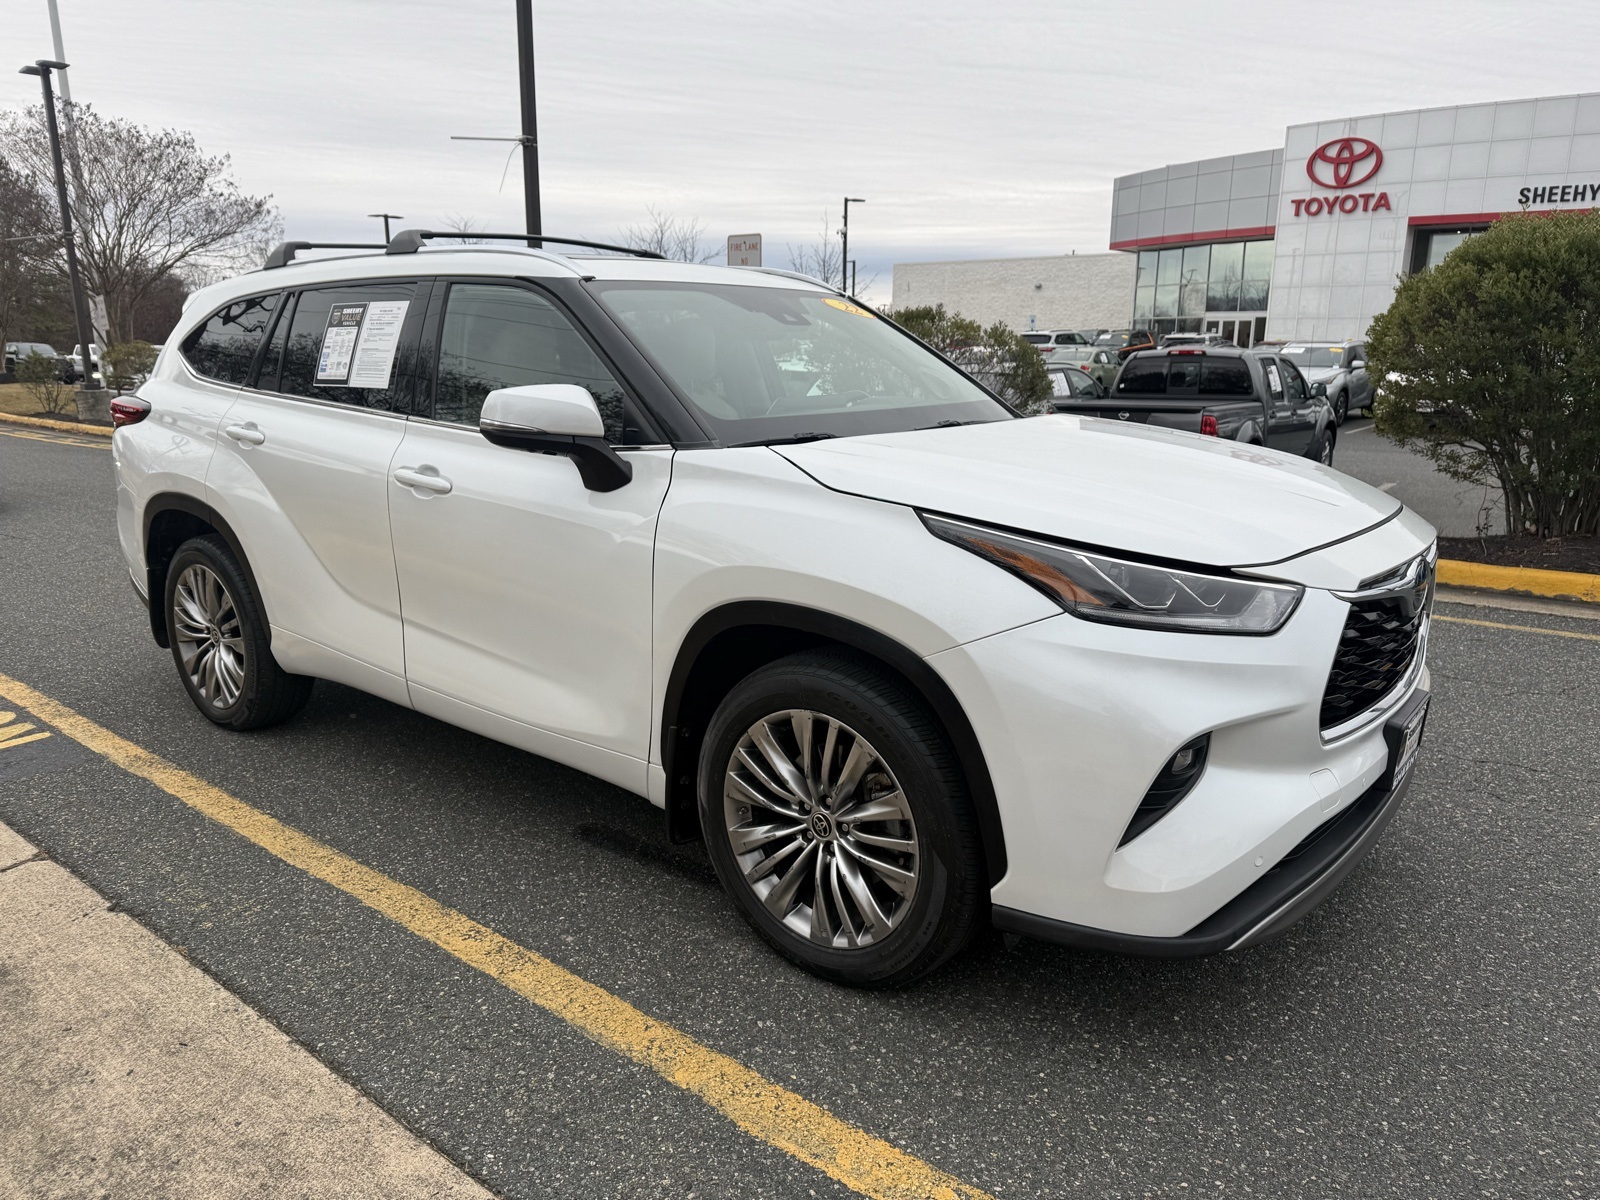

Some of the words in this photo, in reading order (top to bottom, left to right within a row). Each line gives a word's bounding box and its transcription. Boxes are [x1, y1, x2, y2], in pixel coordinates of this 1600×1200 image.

[1518, 184, 1600, 204] SHEEHY
[1291, 192, 1391, 217] TOYOTA
[730, 243, 743, 251] FIRE
[744, 242, 759, 251] LANE
[740, 257, 749, 265] NO
